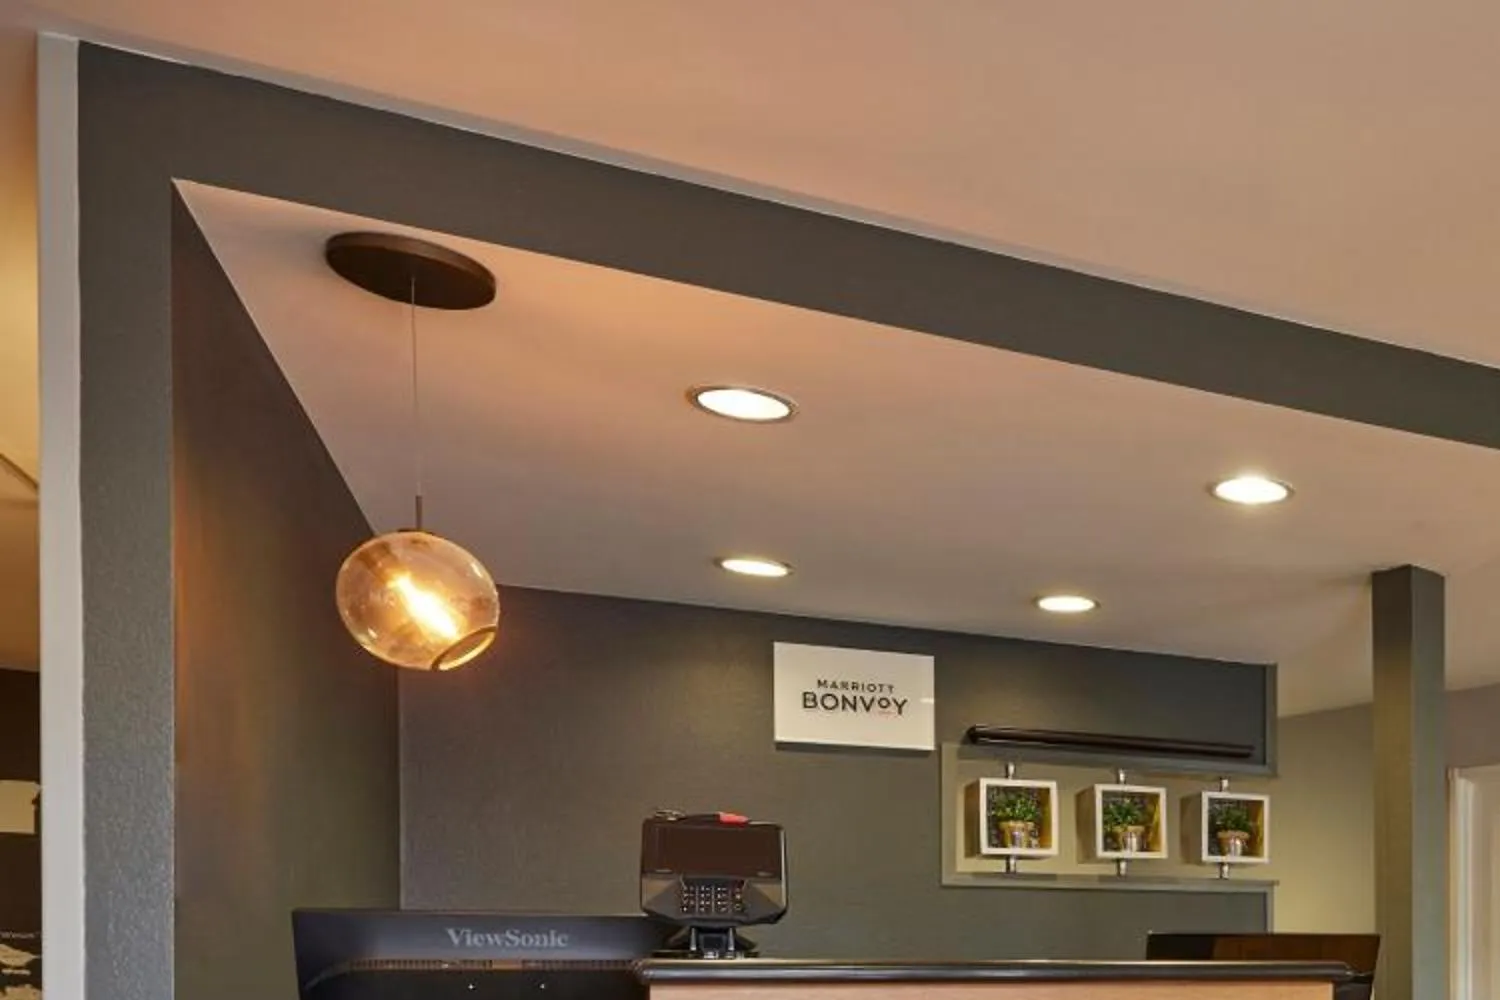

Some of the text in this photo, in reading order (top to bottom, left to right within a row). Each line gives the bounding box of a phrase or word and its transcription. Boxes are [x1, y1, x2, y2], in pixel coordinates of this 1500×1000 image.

[817, 679, 895, 693] MARRIOTT
[802, 691, 908, 715] BONVOY
[447, 927, 570, 947] ViewSonic
